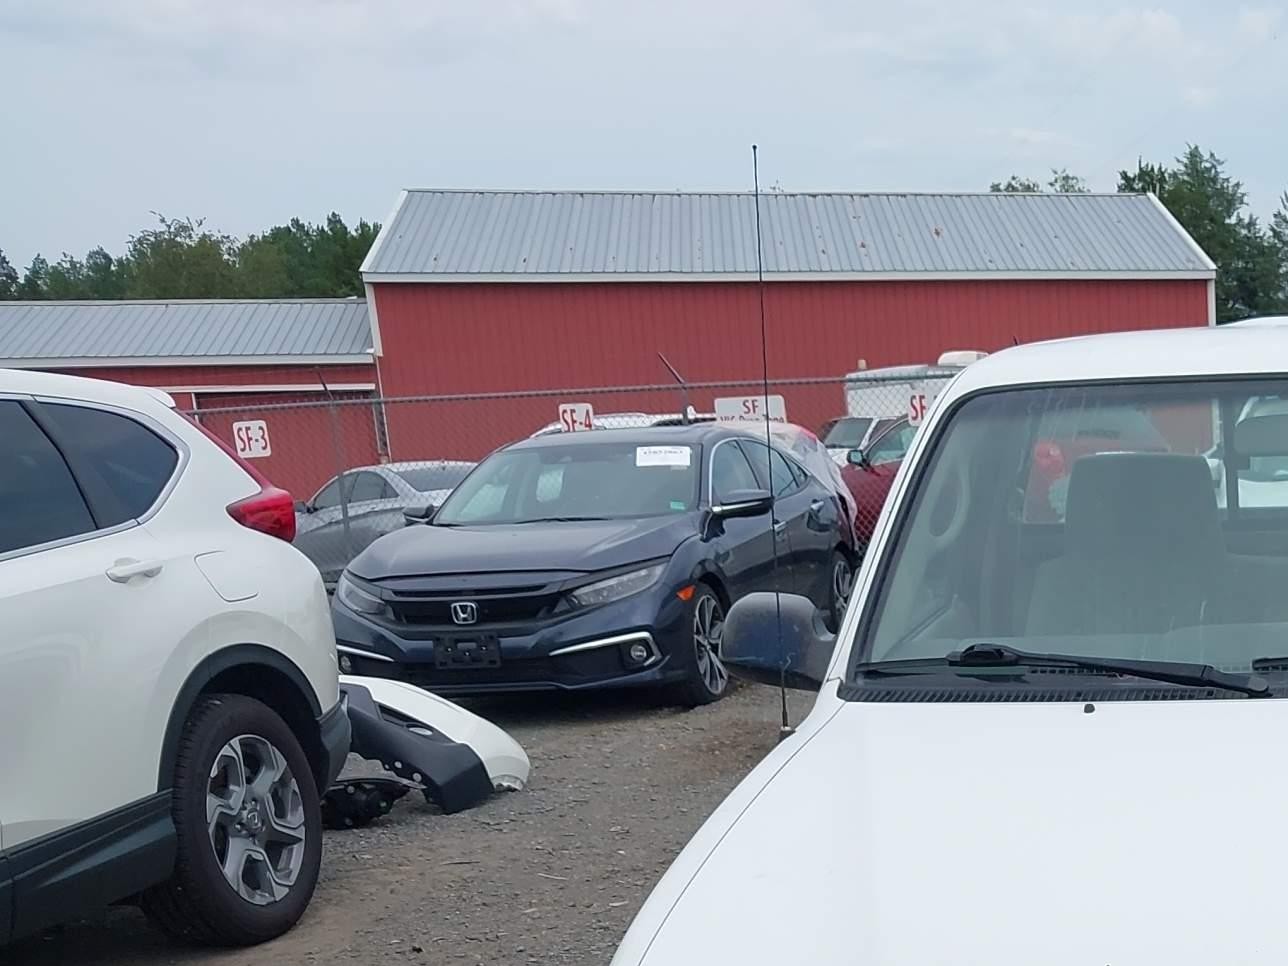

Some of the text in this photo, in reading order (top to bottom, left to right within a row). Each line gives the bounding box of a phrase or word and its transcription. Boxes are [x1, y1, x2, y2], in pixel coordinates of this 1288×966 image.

[742, 398, 760, 414] SF
[911, 394, 932, 420] SF
[562, 408, 593, 432] SF-4
[236, 426, 268, 452] SF-3
